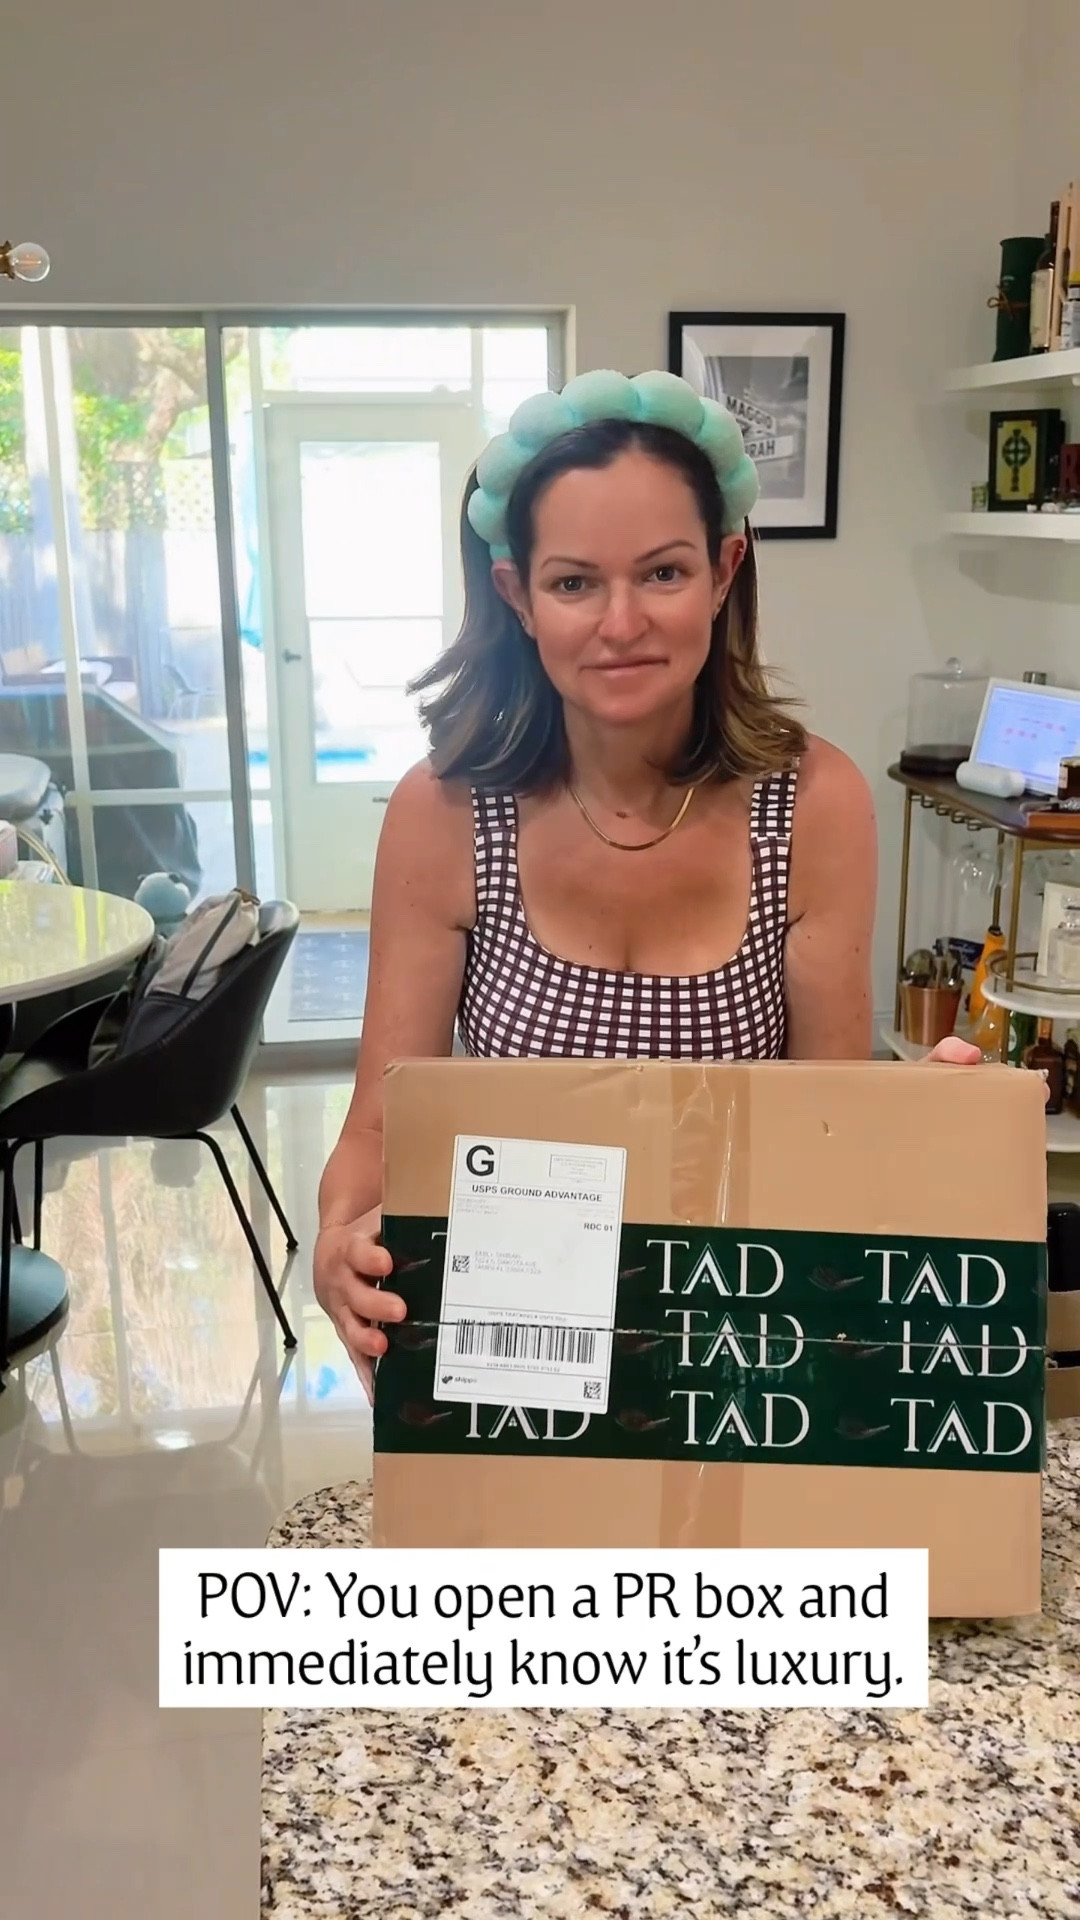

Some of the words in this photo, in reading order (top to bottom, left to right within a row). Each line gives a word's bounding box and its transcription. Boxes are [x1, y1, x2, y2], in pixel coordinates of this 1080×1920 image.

[726, 395, 773, 430] MAGGIO
[466, 1144, 495, 1177] G
[472, 1184, 498, 1194] USPS
[500, 1186, 542, 1197] GROUND
[544, 1189, 602, 1202] ADVANTAGE
[583, 1222, 602, 1231] RDC
[646, 1239, 785, 1298] TAD
[864, 1249, 1007, 1309] TAD
[664, 1309, 805, 1370] TAD
[670, 1391, 810, 1449] TAD
[890, 1398, 1033, 1457] TAD
